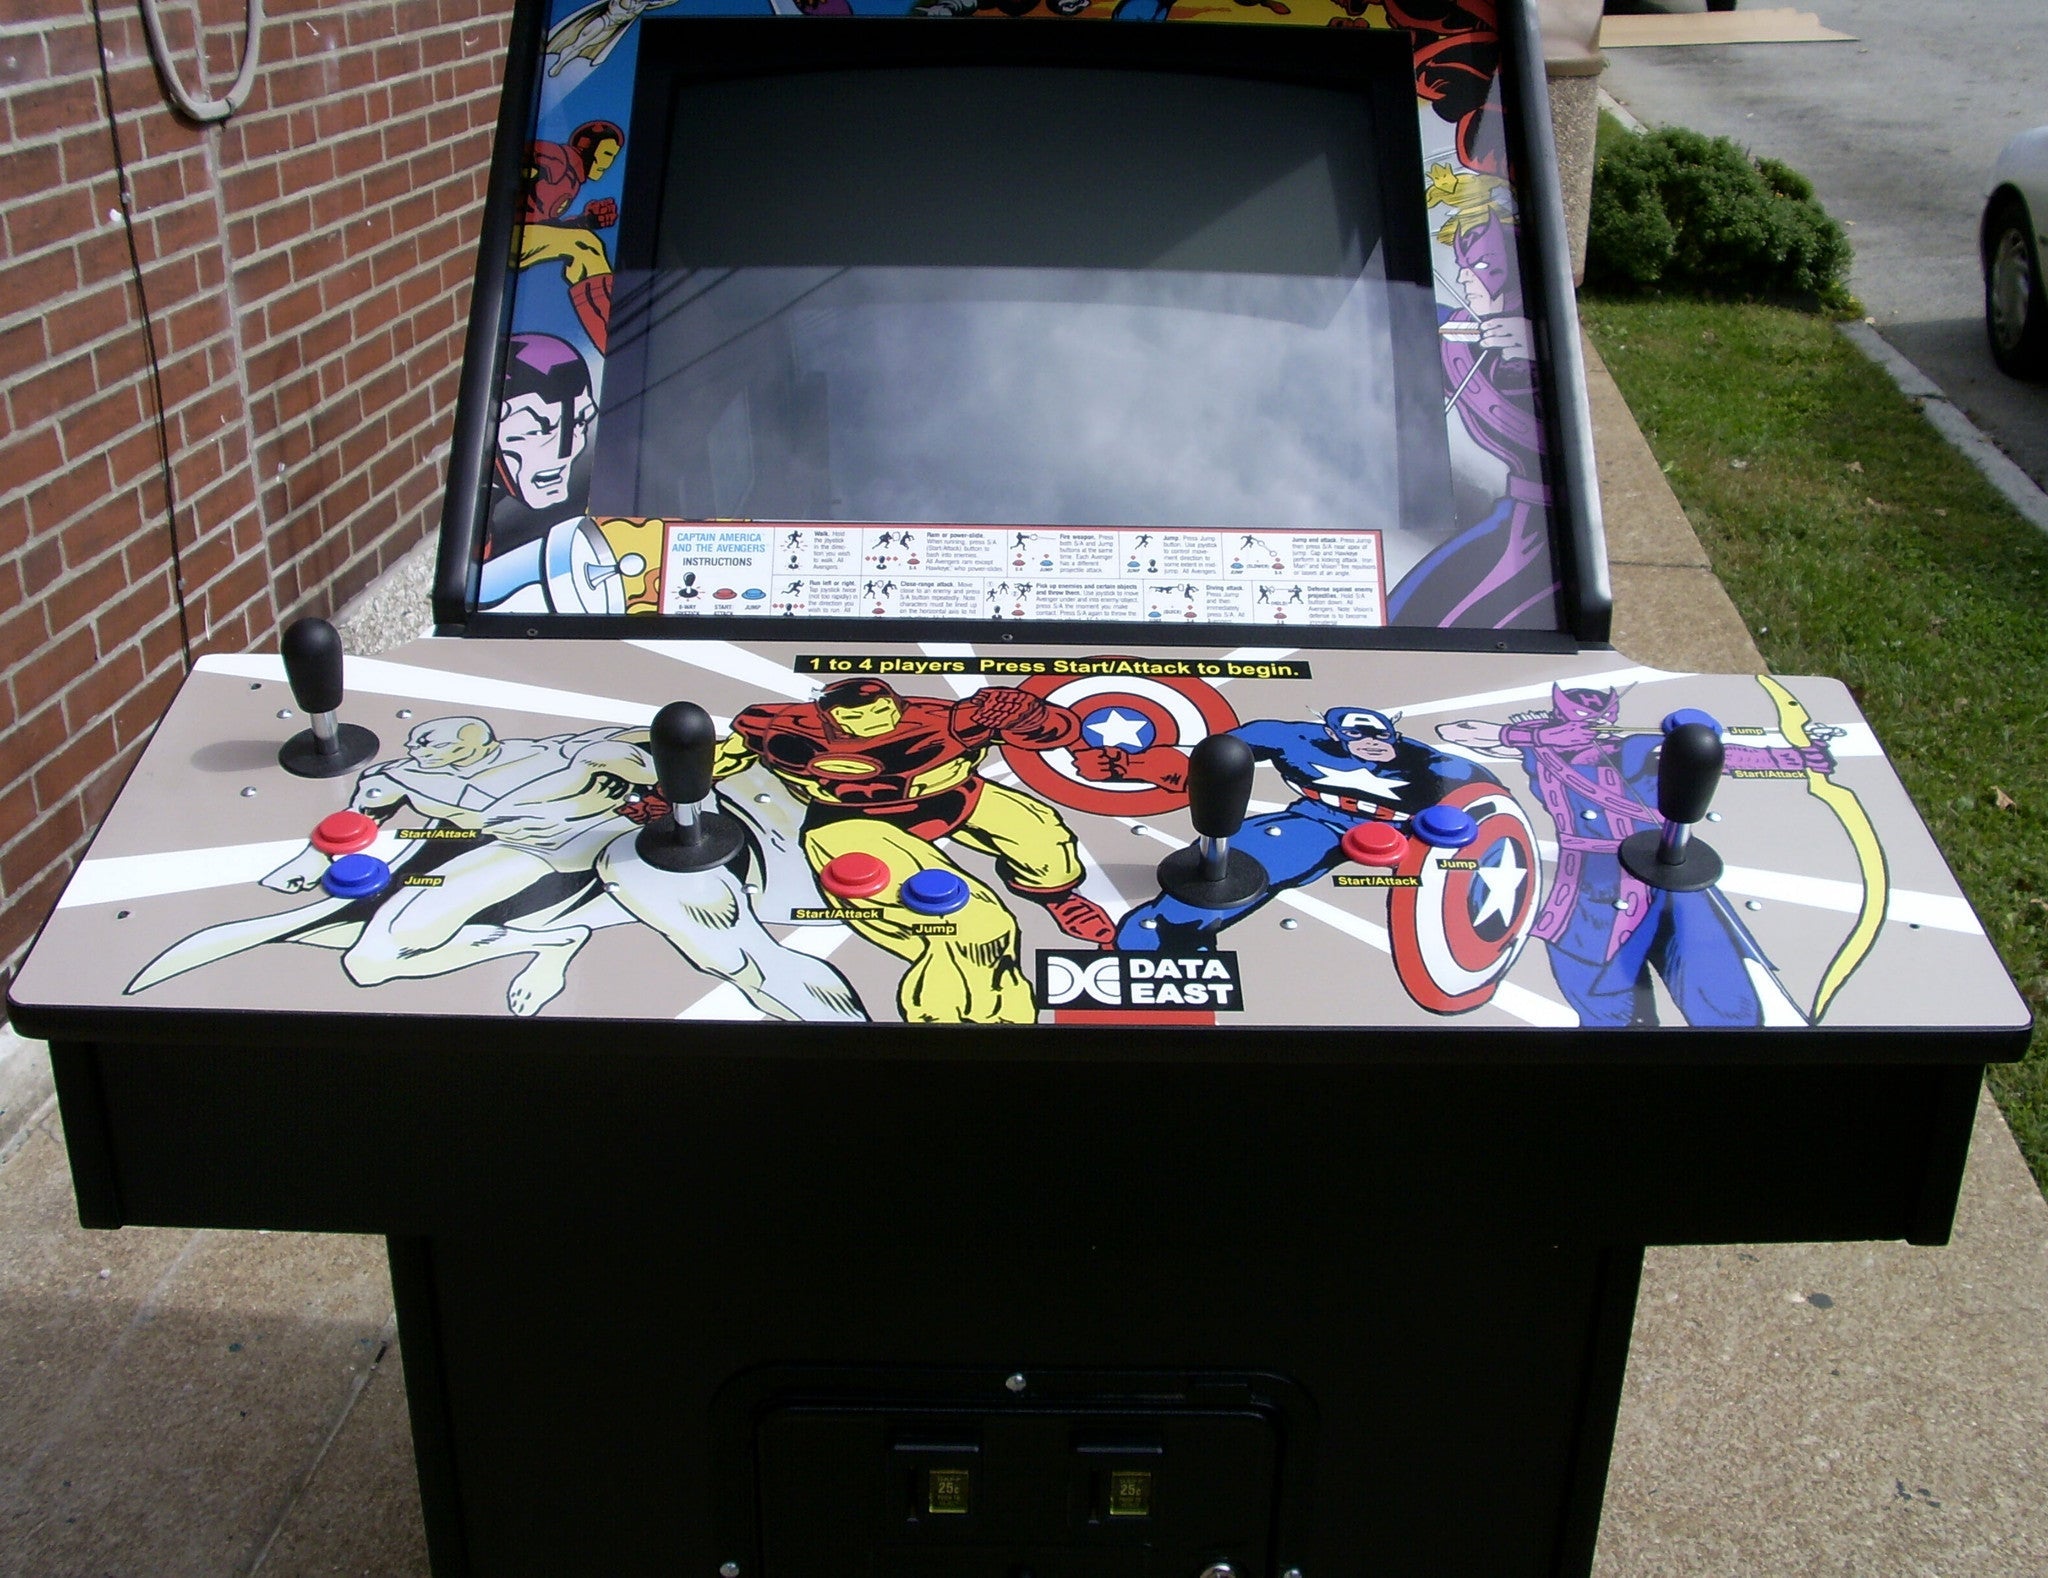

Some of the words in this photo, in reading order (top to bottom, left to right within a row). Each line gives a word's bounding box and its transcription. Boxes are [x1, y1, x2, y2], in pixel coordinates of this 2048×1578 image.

[677, 533, 715, 541] CAPTAIN
[720, 533, 761, 541] AMERICA
[672, 544, 691, 552] AND
[696, 544, 713, 552] THE
[717, 544, 766, 552] AVENGERS
[683, 557, 752, 566] INSTRUCTIONS
[809, 657, 819, 671] 1
[828, 657, 853, 671] to
[859, 658, 873, 671] 4
[879, 658, 965, 675] players
[979, 659, 1046, 673] Press
[1053, 659, 1190, 675] Start/Attack
[1197, 662, 1220, 675] to
[1226, 662, 1300, 679] begin.
[1734, 770, 1806, 778] Start/Attack
[399, 830, 477, 839] Start/Attack
[1439, 860, 1477, 869] Jump
[404, 876, 443, 886] Jump
[1338, 877, 1418, 886] Start/Attack
[796, 909, 879, 919] Start/Attack
[915, 924, 955, 935] Jump
[1129, 958, 1231, 979] DATA
[1130, 983, 1233, 1005] EAST
